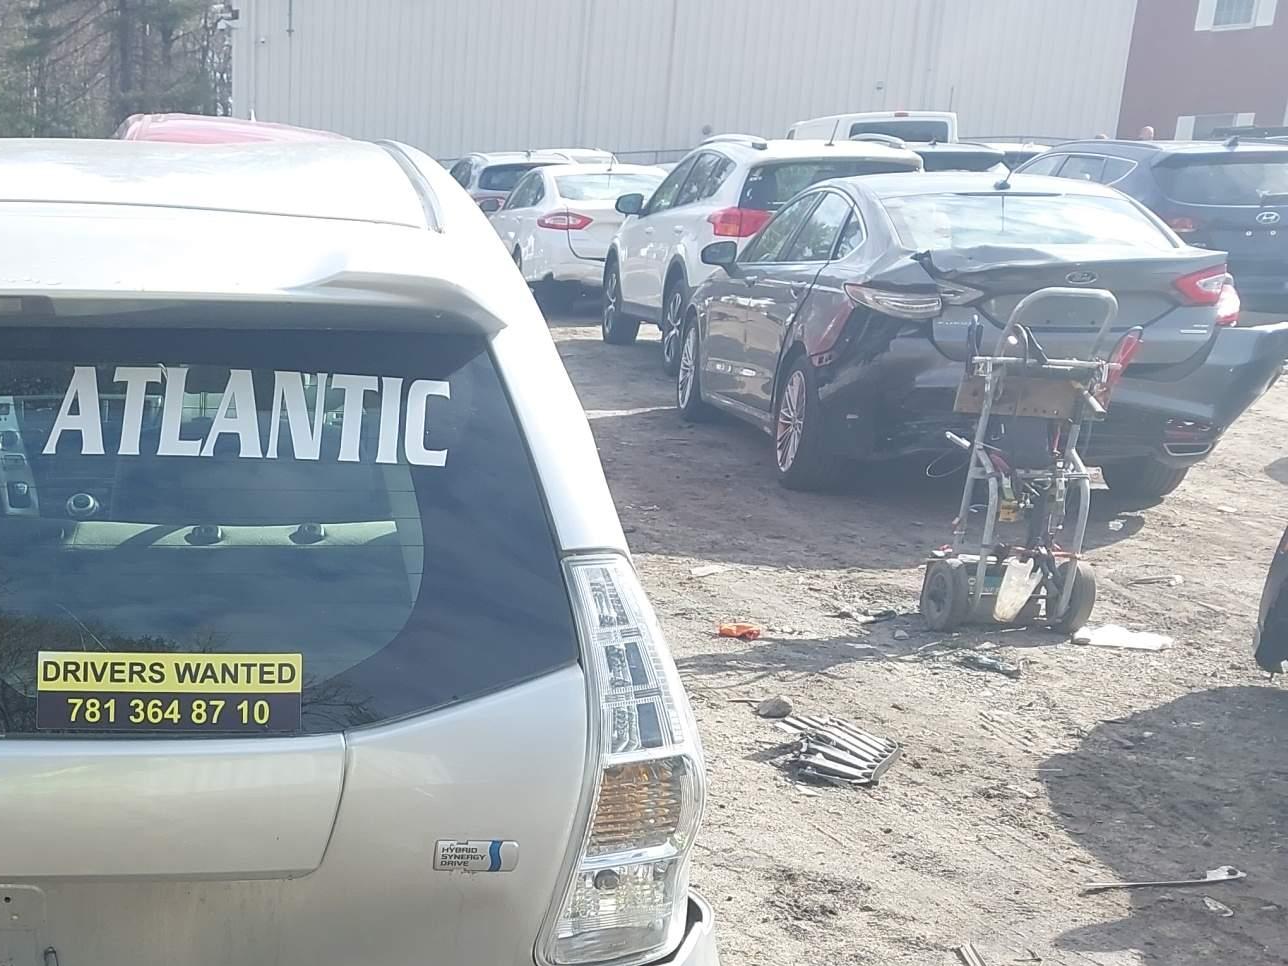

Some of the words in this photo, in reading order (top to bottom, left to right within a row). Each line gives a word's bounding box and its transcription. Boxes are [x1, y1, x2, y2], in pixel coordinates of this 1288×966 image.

[42, 365, 451, 467] ATLANTIC
[42, 660, 166, 683] DRIVERS
[175, 662, 296, 684] WANTED
[67, 698, 116, 723] 781
[129, 699, 181, 724] 364
[191, 700, 225, 724] 87
[237, 700, 270, 725] 10
[440, 853, 487, 861] SYNERGY
[441, 846, 478, 854] HYBRID
